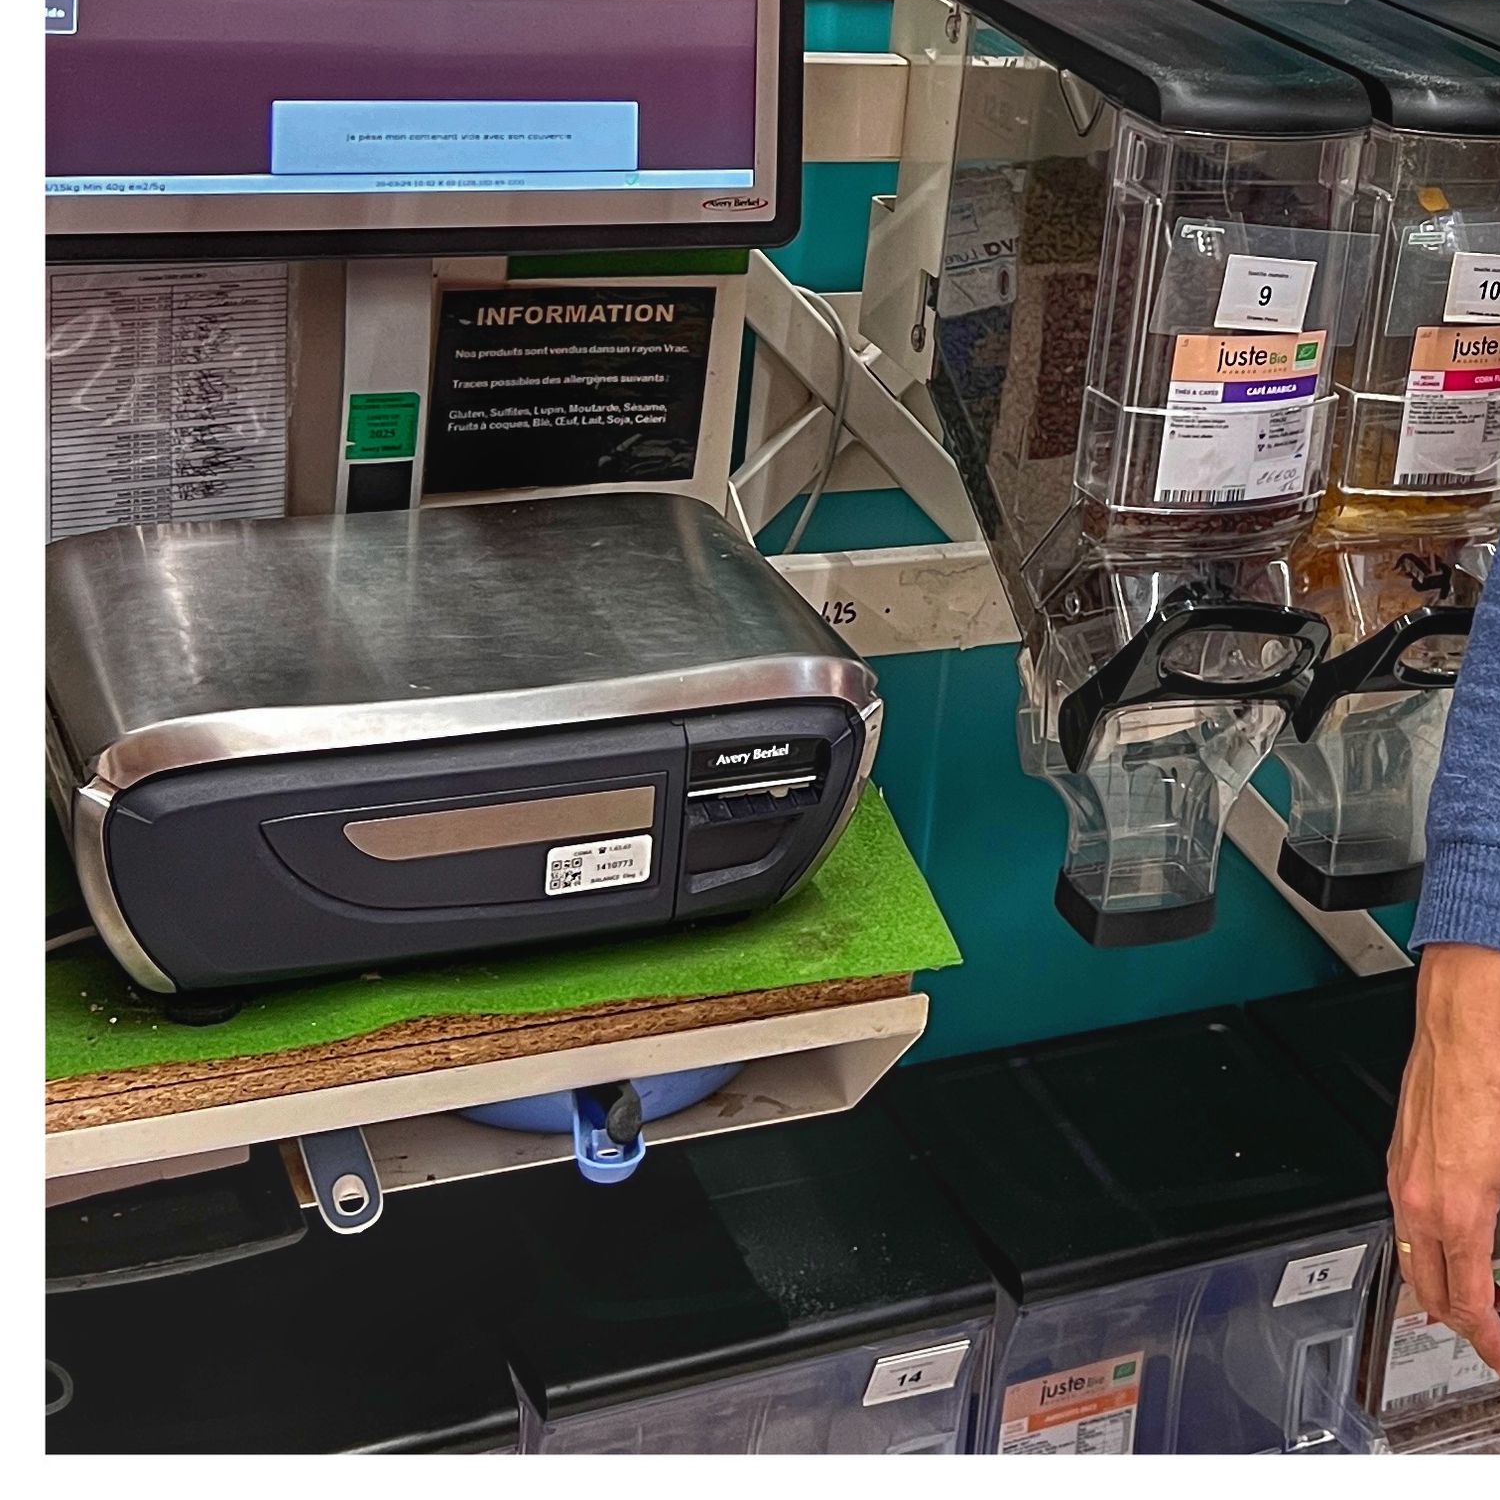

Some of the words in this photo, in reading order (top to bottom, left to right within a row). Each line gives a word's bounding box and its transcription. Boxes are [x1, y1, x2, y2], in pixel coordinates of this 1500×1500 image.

[83, 181, 103, 191] Min
[105, 182, 125, 192] 40g
[1258, 285, 1273, 306] 9
[1479, 279, 1500, 301] 10
[476, 303, 675, 326] INFORMATION
[455, 349, 476, 359] Nos
[478, 347, 523, 360] produits
[524, 346, 548, 357] sont
[549, 345, 588, 355] vendus
[588, 344, 616, 354] dans
[616, 345, 630, 353] un
[631, 344, 662, 355] rayon
[1452, 332, 1499, 363] juste
[1217, 341, 1268, 373] juste
[1269, 353, 1288, 366] Bio
[452, 378, 488, 389] Traces
[490, 376, 541, 389] possibles
[542, 375, 562, 385] des
[563, 373, 620, 387] allergènes
[620, 373, 665, 383] suivants
[1474, 375, 1493, 384] CORN
[1246, 385, 1266, 396] CAFÉ
[1266, 383, 1297, 395] ARABICA
[449, 410, 488, 420] Gluten,
[489, 406, 532, 418] Sulfites,
[533, 405, 567, 416] Lupin,
[568, 403, 622, 414] Moutarde,
[623, 402, 668, 413] Sésame,
[447, 421, 479, 432] Fruits
[480, 422, 487, 431] à
[488, 420, 531, 431] coques,
[532, 417, 553, 428] Blé,
[554, 415, 580, 427] Œuf,
[581, 414, 606, 426] Lait,
[606, 414, 634, 425] Soja,
[635, 412, 667, 424] Céleri
[716, 750, 750, 766] Avery
[753, 743, 789, 760] Berkel
[596, 858, 634, 871] 1410773
[1306, 1267, 1330, 1284] 15
[897, 1369, 922, 1387] 14
[1039, 1375, 1086, 1406] juste
